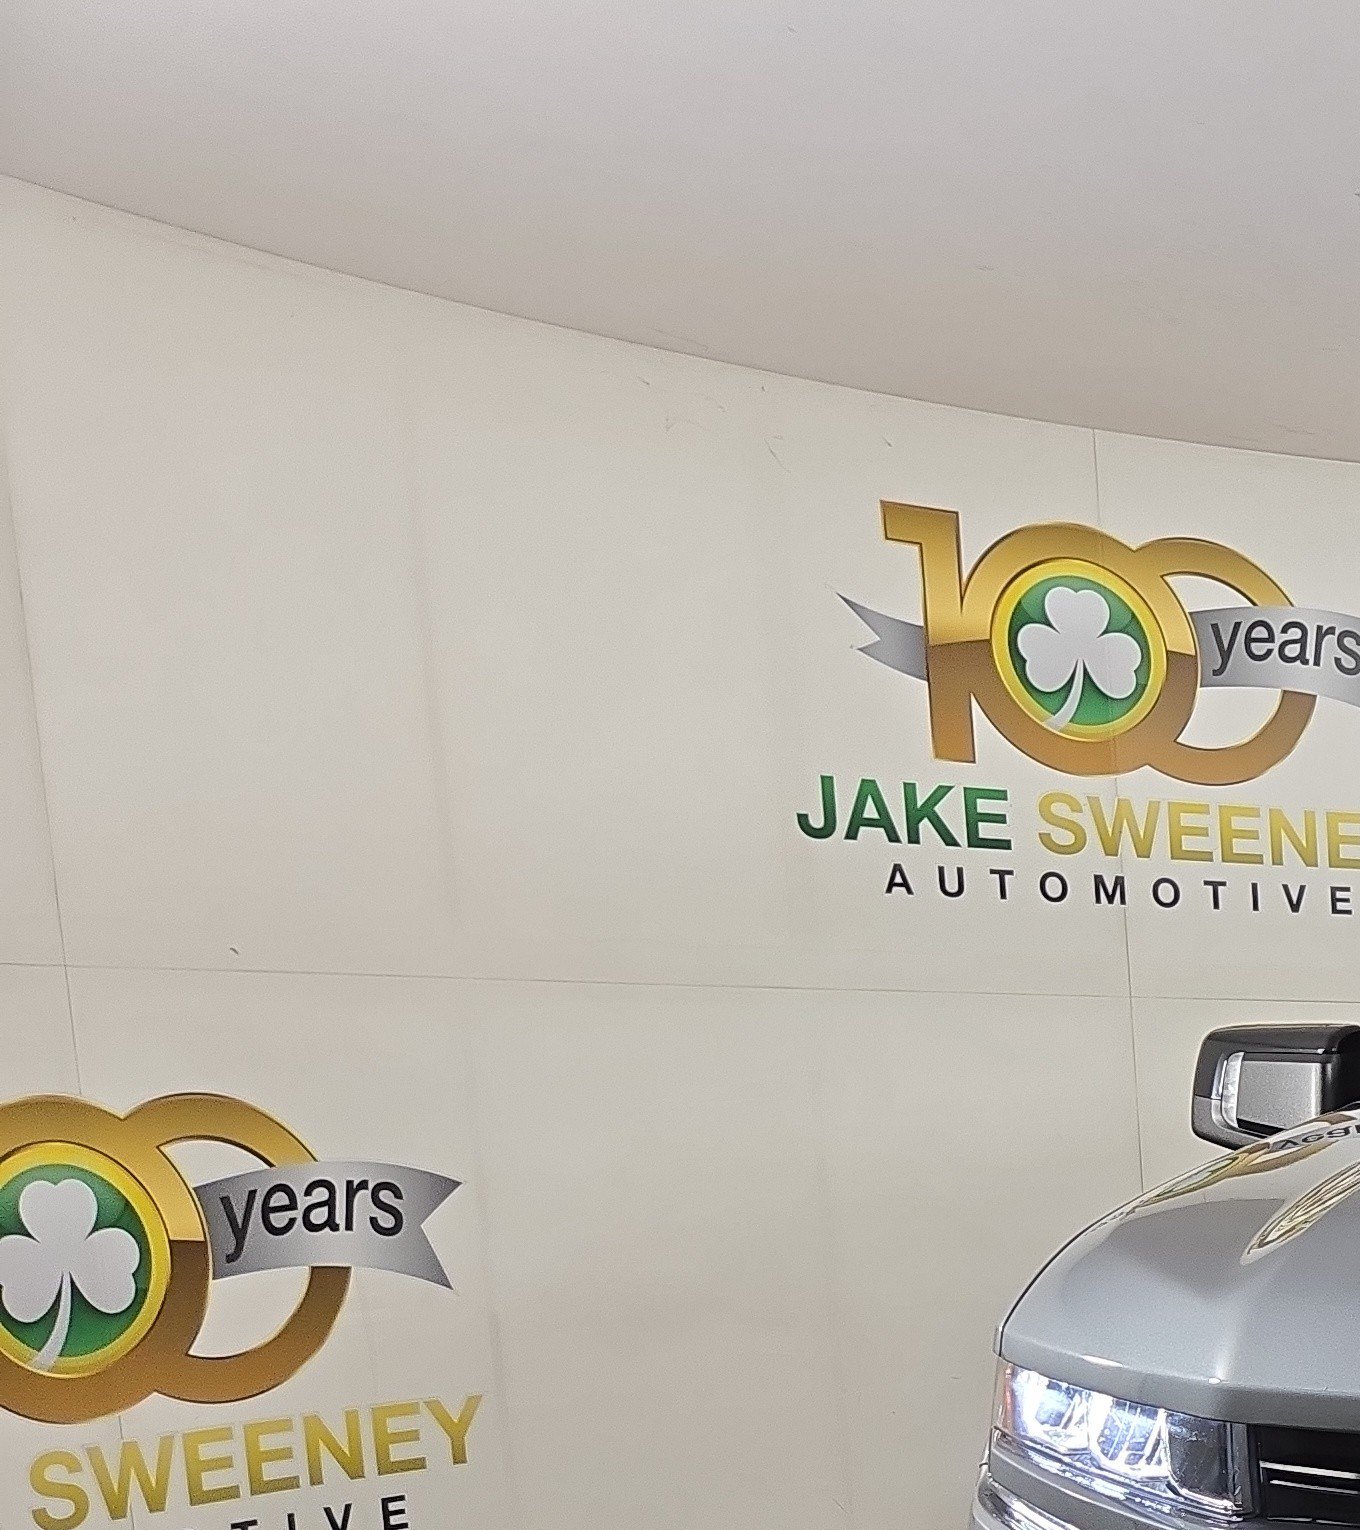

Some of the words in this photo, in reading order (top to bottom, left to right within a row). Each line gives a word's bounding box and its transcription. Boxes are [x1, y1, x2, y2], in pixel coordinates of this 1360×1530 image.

[796, 774, 1013, 851] JAKE
[885, 863, 1353, 915] AUTOMOTIVE
[219, 1178, 405, 1263] years
